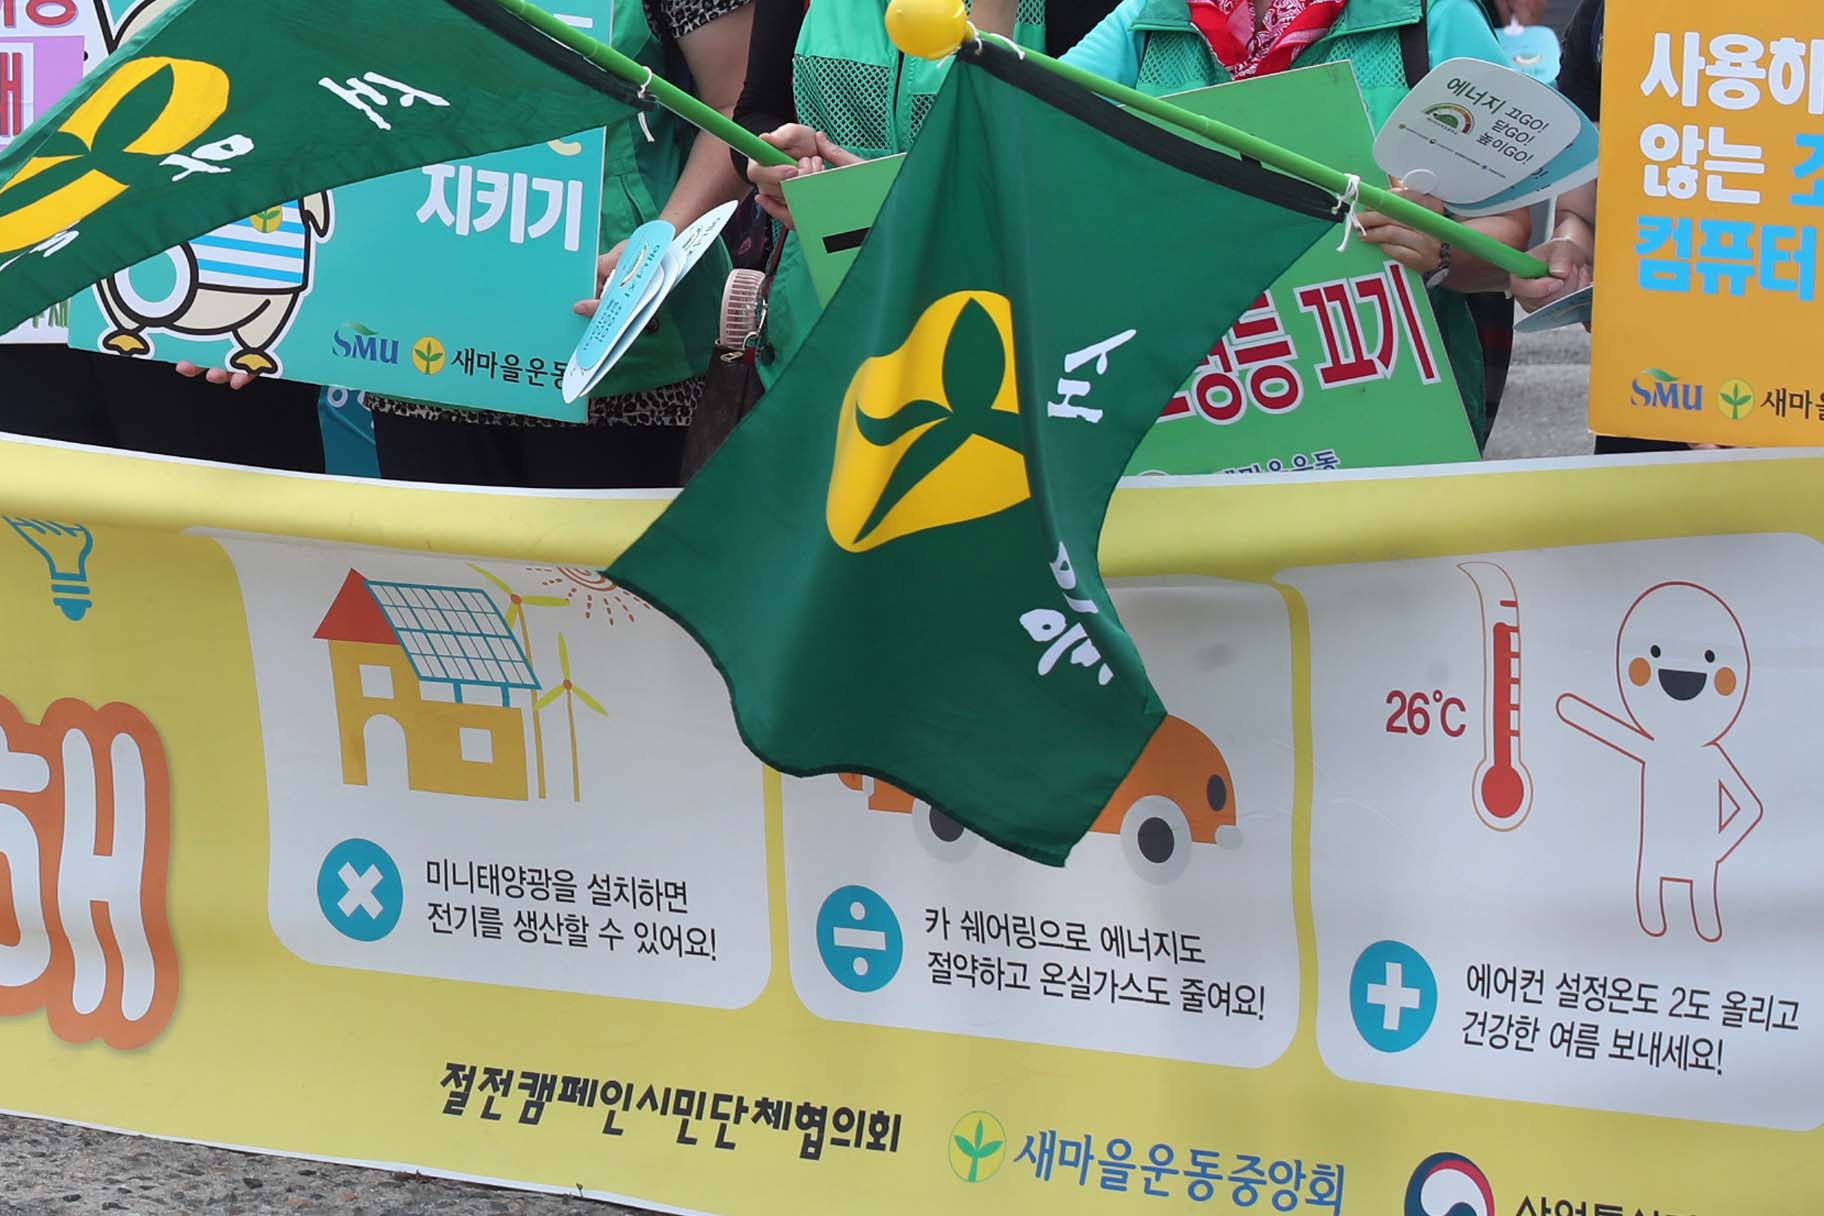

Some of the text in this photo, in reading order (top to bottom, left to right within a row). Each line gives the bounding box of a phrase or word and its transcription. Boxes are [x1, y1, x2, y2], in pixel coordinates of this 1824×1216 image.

[1447, 78, 1506, 115] 에너지
[1639, 123, 1765, 205] 않는
[416, 163, 583, 252] 지키기
[1634, 215, 1817, 301] 컴퓨터
[333, 322, 399, 365] SMU
[1293, 260, 1441, 390] 끄기
[451, 347, 567, 390] 새마을운동
[1631, 368, 1703, 412] SMU
[426, 859, 688, 915] 미니태양광을 설치하면
[426, 902, 718, 962] 전기를 생산할 수 있어요!
[925, 906, 1207, 966] 카 쉐어링으로 에너지도
[927, 951, 1265, 1021] 절약하고 온실가스도 줄여요!
[1466, 963, 1799, 1032] 에어컨 설정온도 2도 올리고
[1462, 1010, 1724, 1075] 건강한 여름 보내세요!
[439, 1062, 902, 1160] 절전캠페인시민단체협의회
[1014, 1129, 1347, 1216] 새마을운동중앙회
